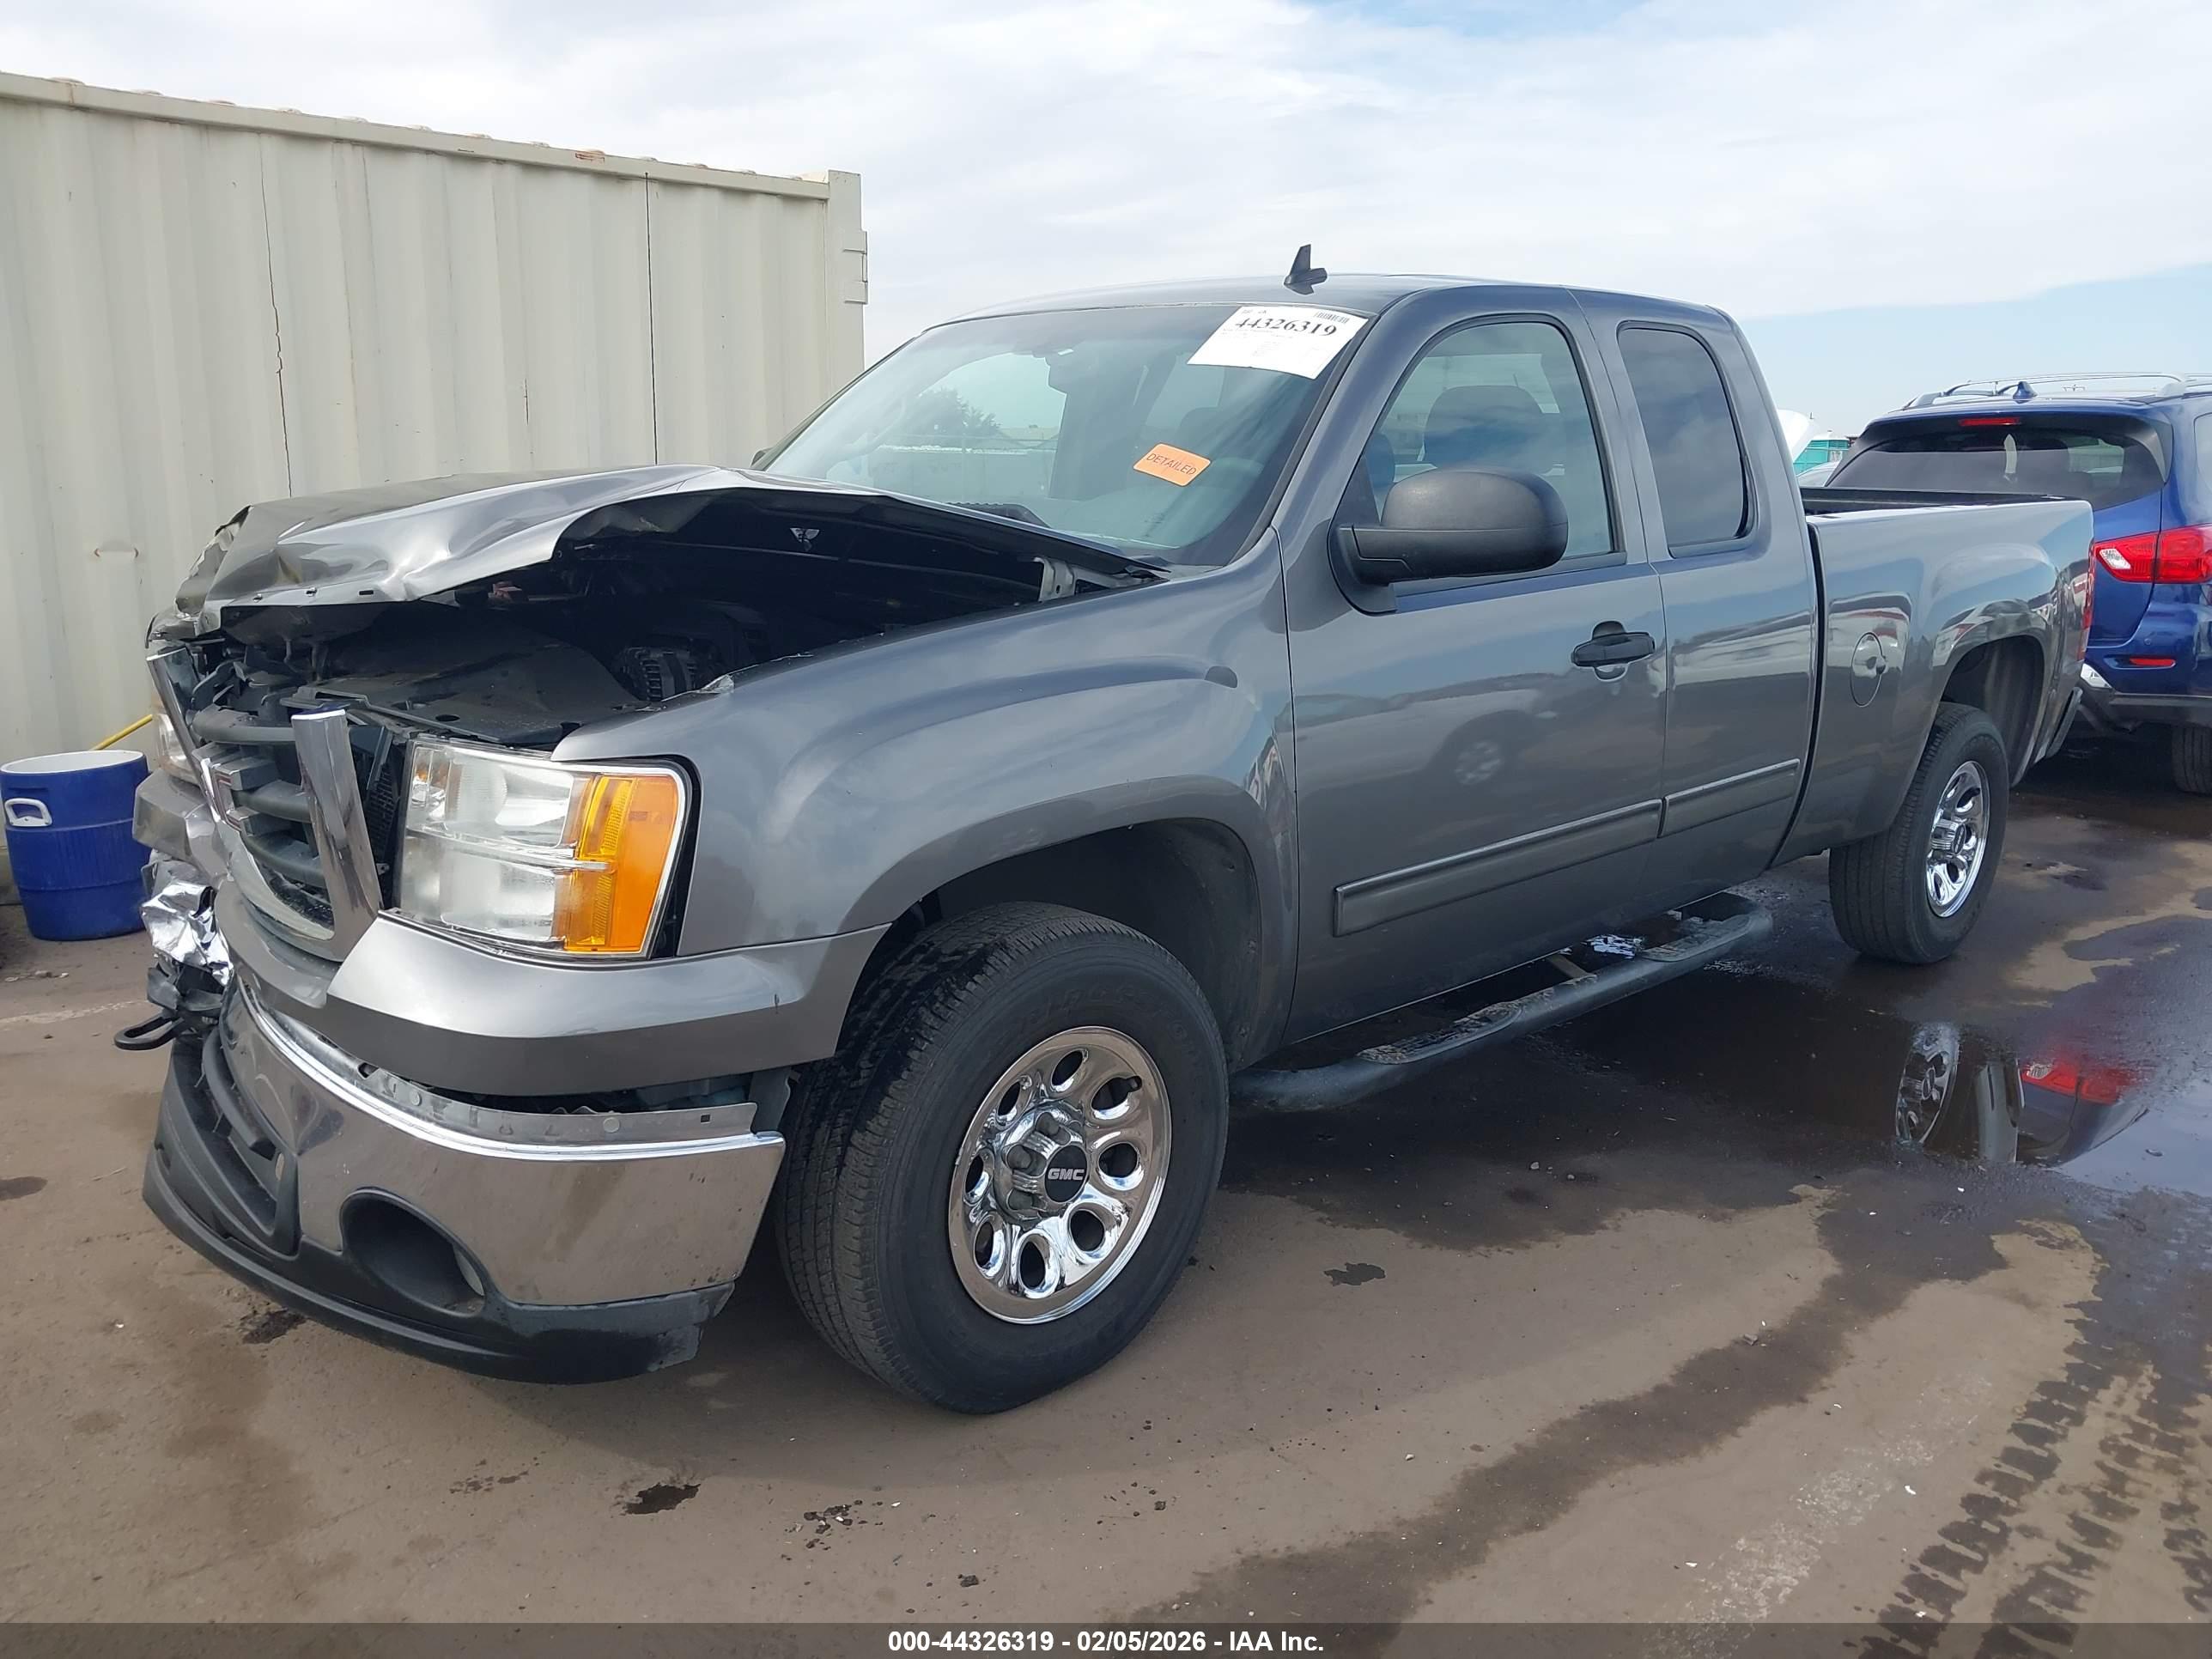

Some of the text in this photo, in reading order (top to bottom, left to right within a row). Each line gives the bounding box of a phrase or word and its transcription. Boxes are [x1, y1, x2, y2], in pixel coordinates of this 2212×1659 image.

[1235, 317, 1337, 337] 44326319
[1146, 451, 1198, 476] DETAILED
[1048, 1169, 1085, 1181] GMC
